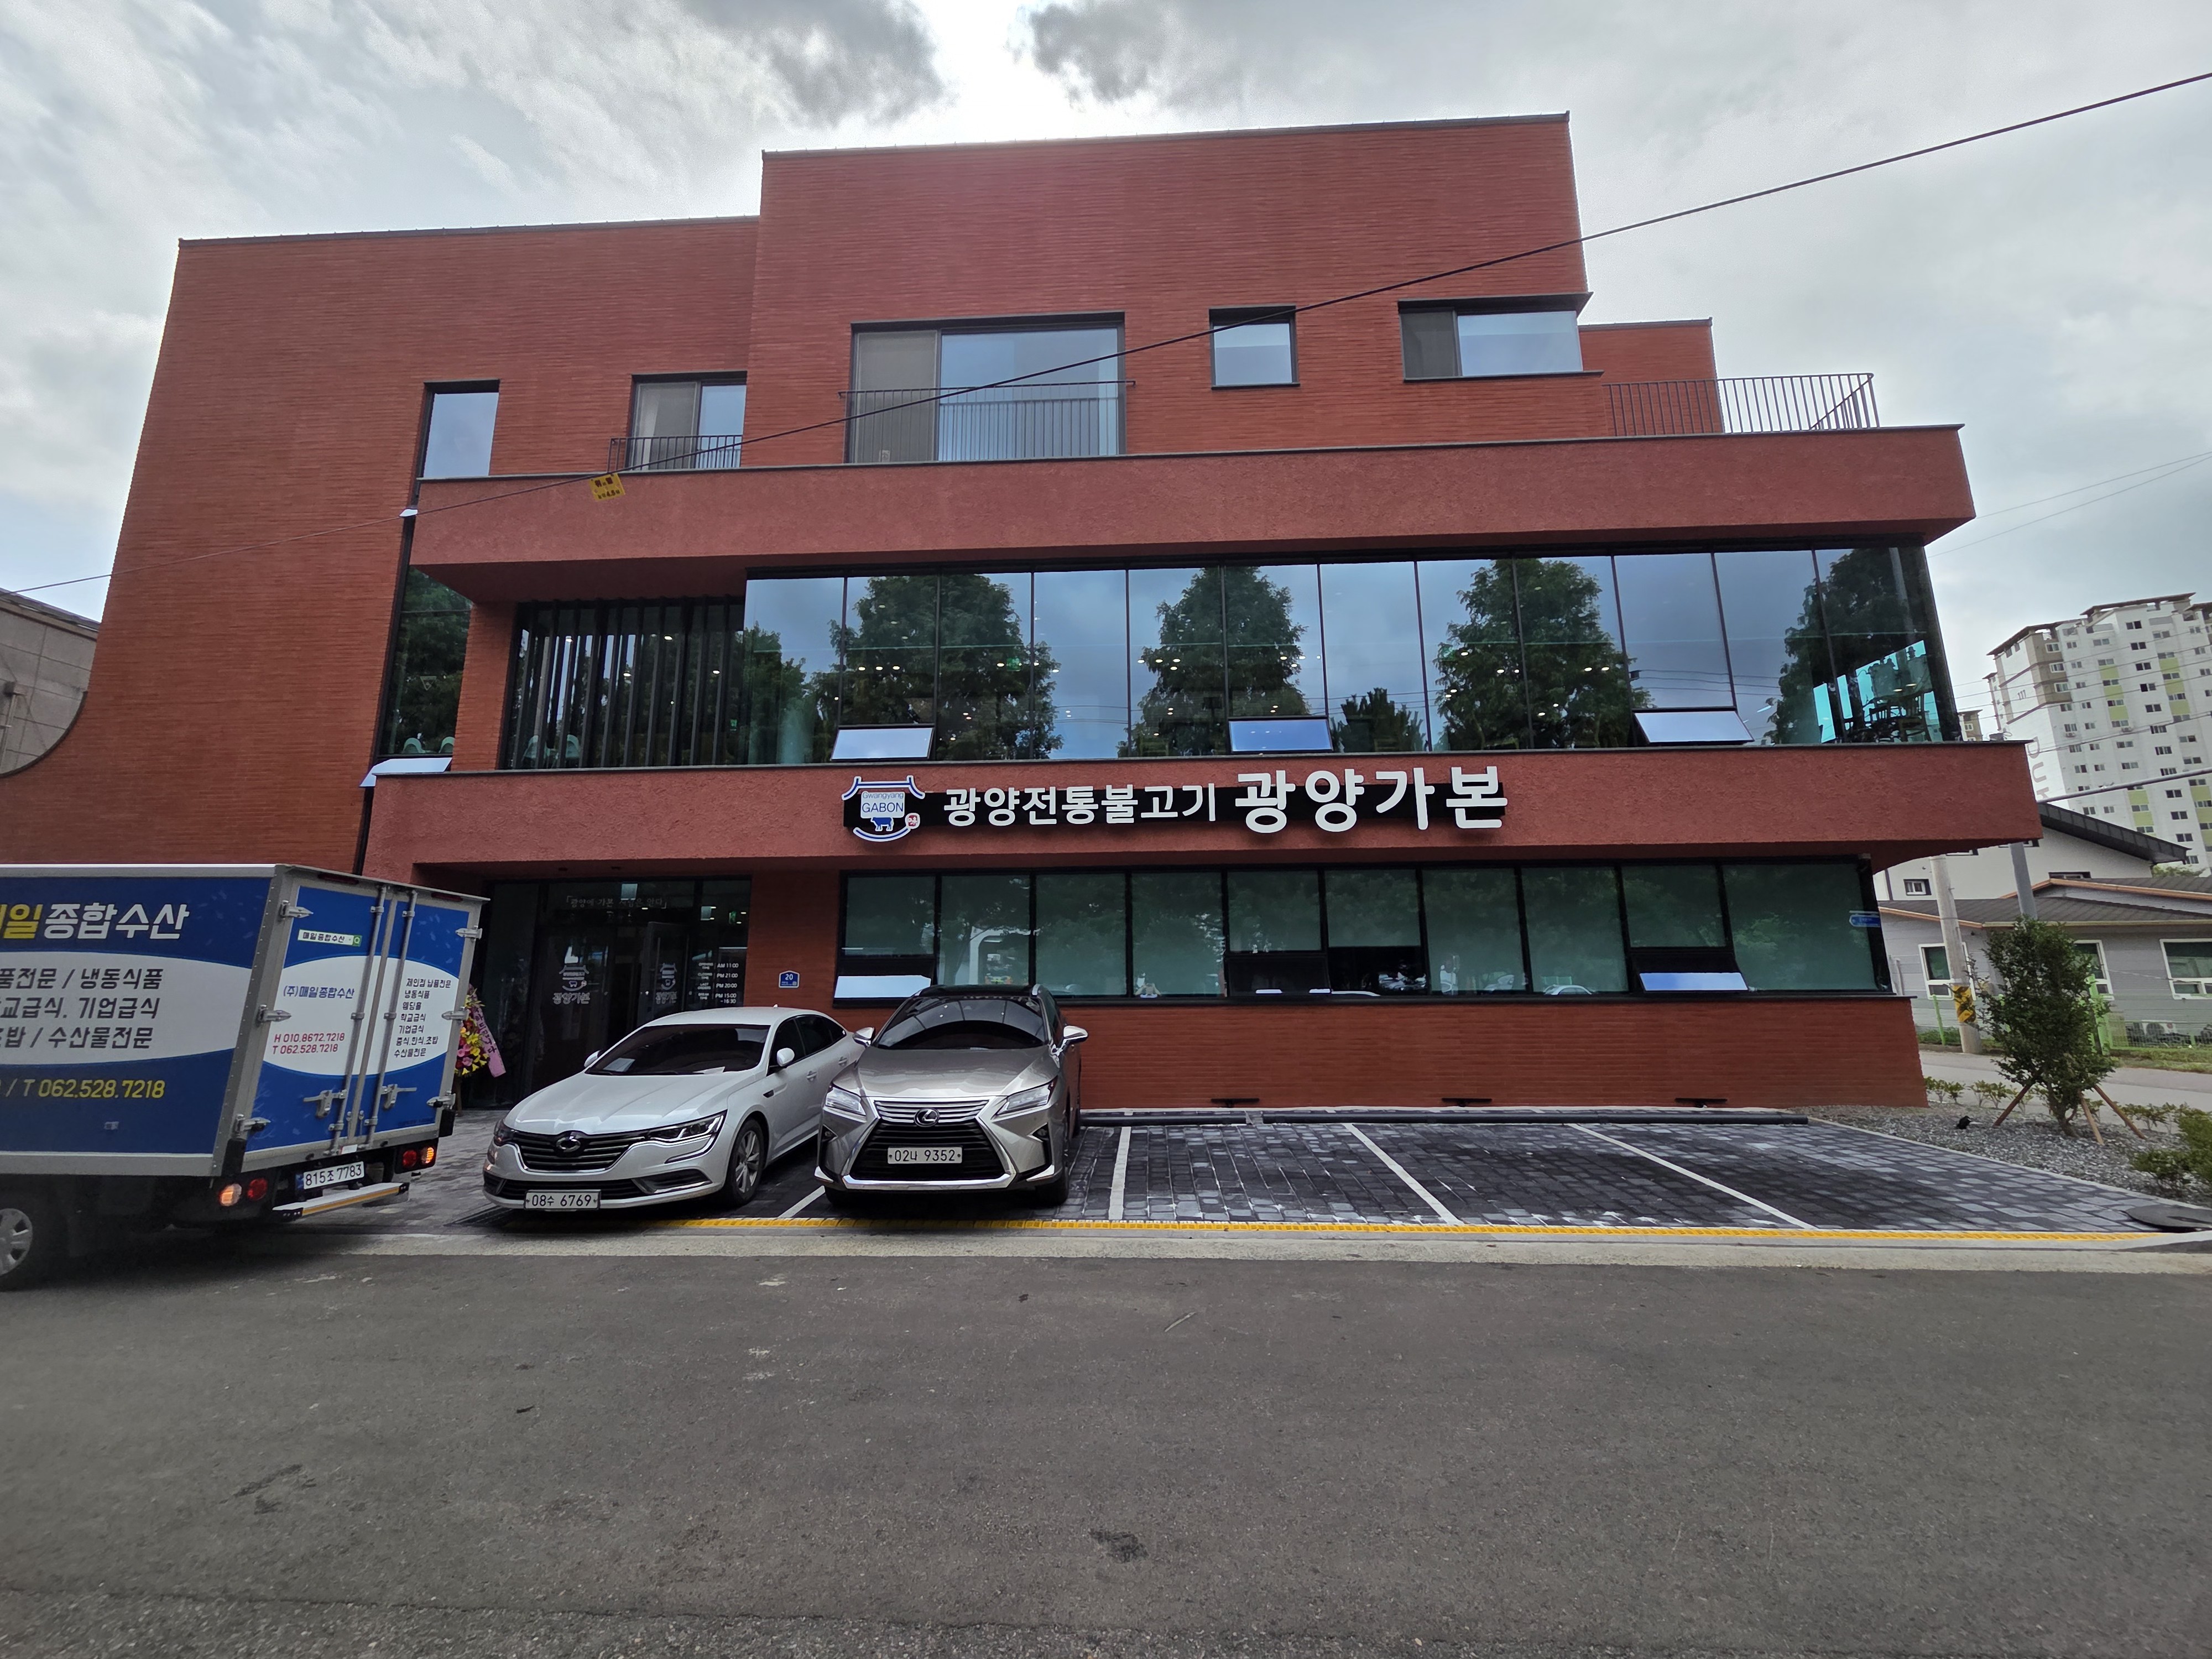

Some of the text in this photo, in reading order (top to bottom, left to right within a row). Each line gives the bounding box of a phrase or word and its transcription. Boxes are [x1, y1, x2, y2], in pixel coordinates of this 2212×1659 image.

[943, 766, 1508, 833] 광양전통불고기 광양가본
[862, 802, 904, 813] GABON
[302, 932, 345, 943] 매일종합수산
[80, 968, 164, 989] 냉동식품
[283, 985, 355, 999] (주)매일종합수산
[404, 990, 430, 999] 냉동식품
[0, 997, 160, 1019] 교급식. 기업급식
[401, 1014, 426, 1022] 학교급식
[399, 1025, 424, 1034] 기업급식
[48, 1027, 154, 1048] 수산물전문
[274, 1033, 345, 1043] H 010.8672.7218
[273, 1044, 338, 1055] T 062.528.7218
[394, 1048, 426, 1057] 수산물전문
[23, 1079, 36, 1097] T
[38, 1079, 166, 1098] 062.528.7218
[895, 1149, 955, 1162] 02나 9352
[305, 1164, 362, 1186] 815조 7783
[532, 1194, 592, 1207] 08수 6769
